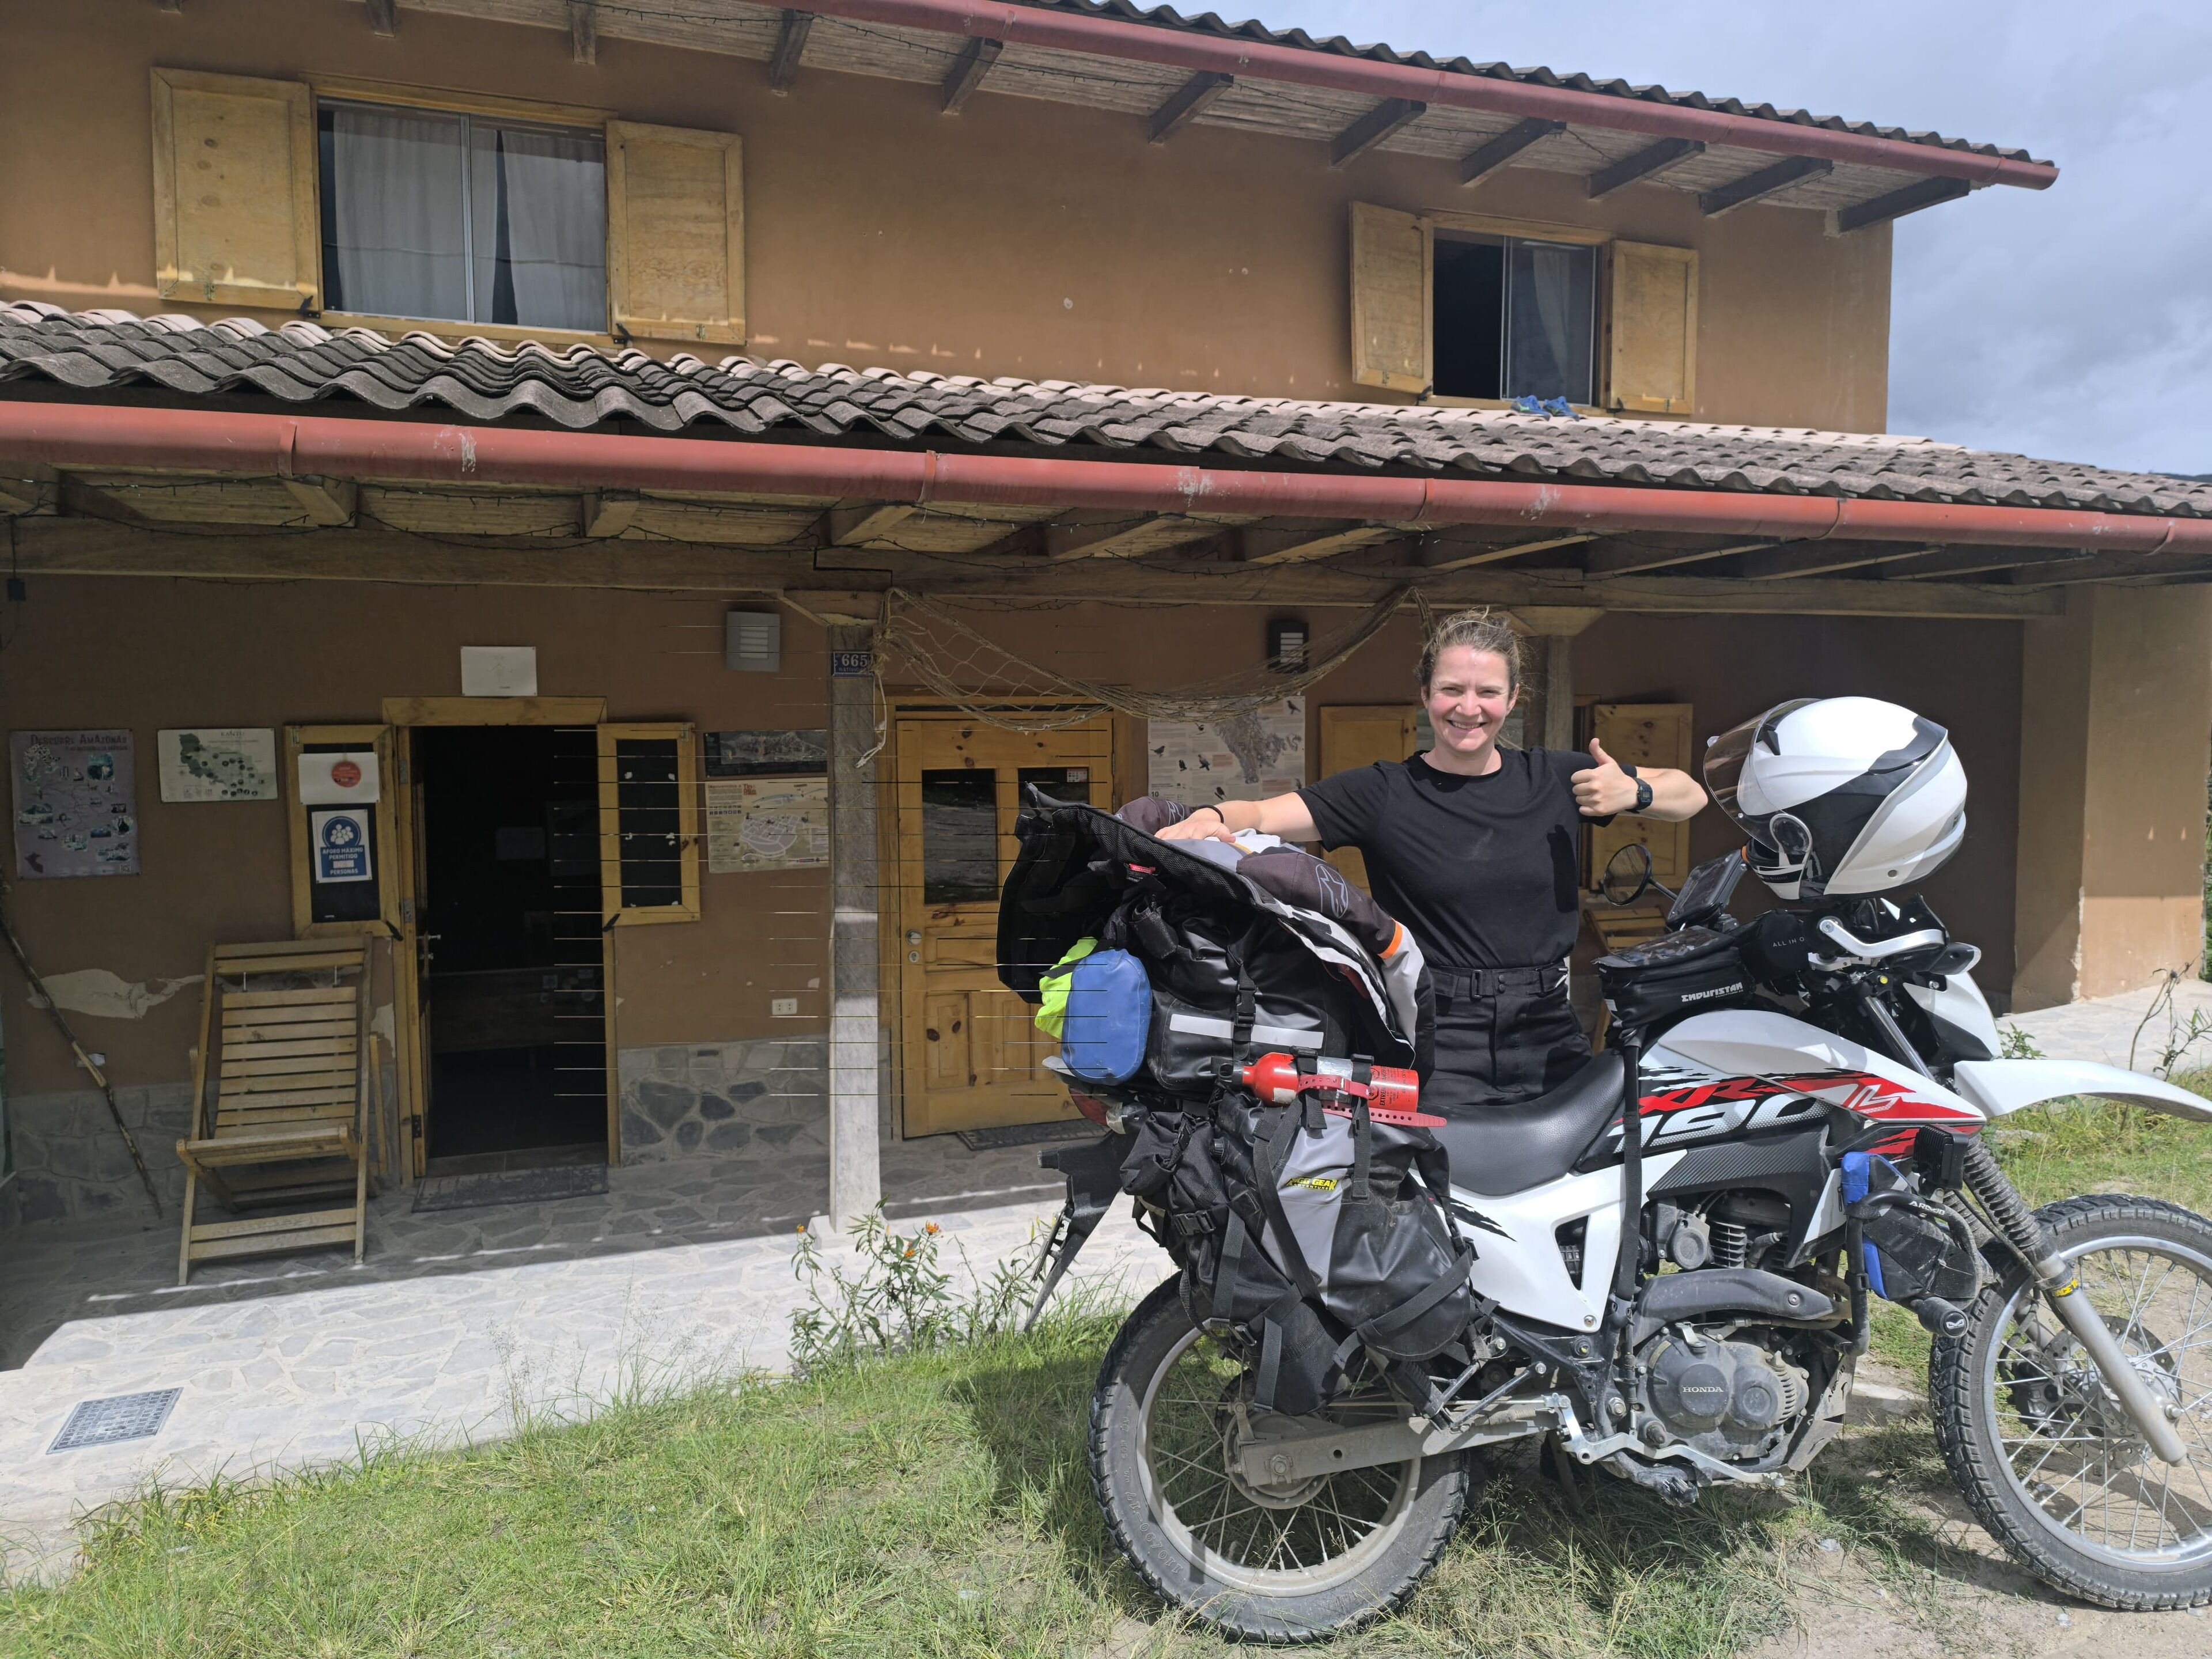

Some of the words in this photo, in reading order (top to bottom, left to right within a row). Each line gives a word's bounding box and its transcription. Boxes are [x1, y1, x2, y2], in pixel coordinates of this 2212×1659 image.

[842, 654, 868, 667] 665
[1681, 982, 1743, 1002] ENDURISTAN
[1607, 1084, 1859, 1153] 190
[1125, 1491, 1183, 1574] 110/90-17
